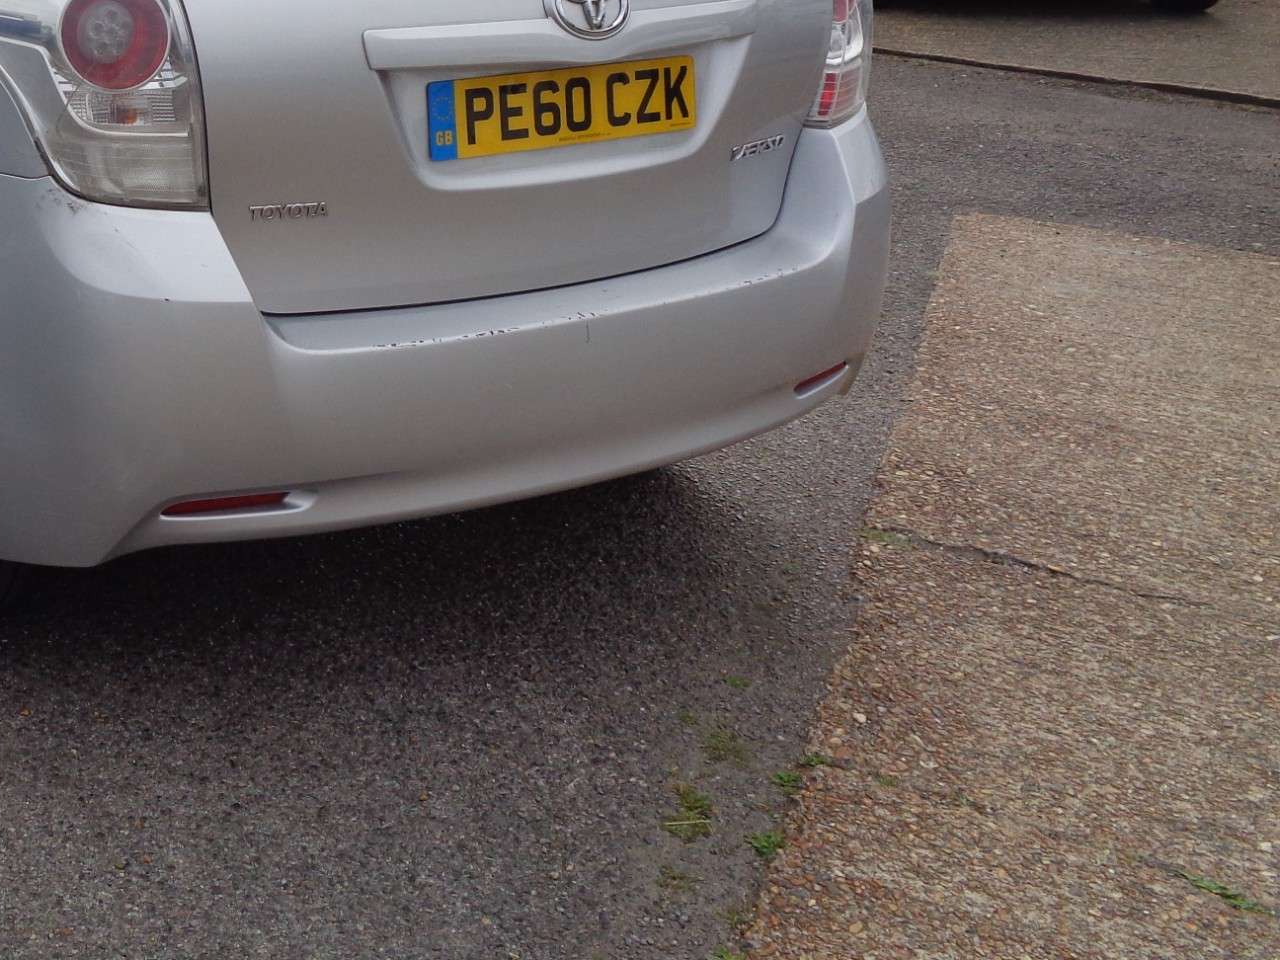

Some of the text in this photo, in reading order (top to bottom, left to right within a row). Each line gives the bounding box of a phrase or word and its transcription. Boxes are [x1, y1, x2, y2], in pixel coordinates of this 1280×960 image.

[464, 65, 689, 145] PE60 CZK
[435, 130, 453, 146] GB
[249, 202, 327, 220] TOYOTA
